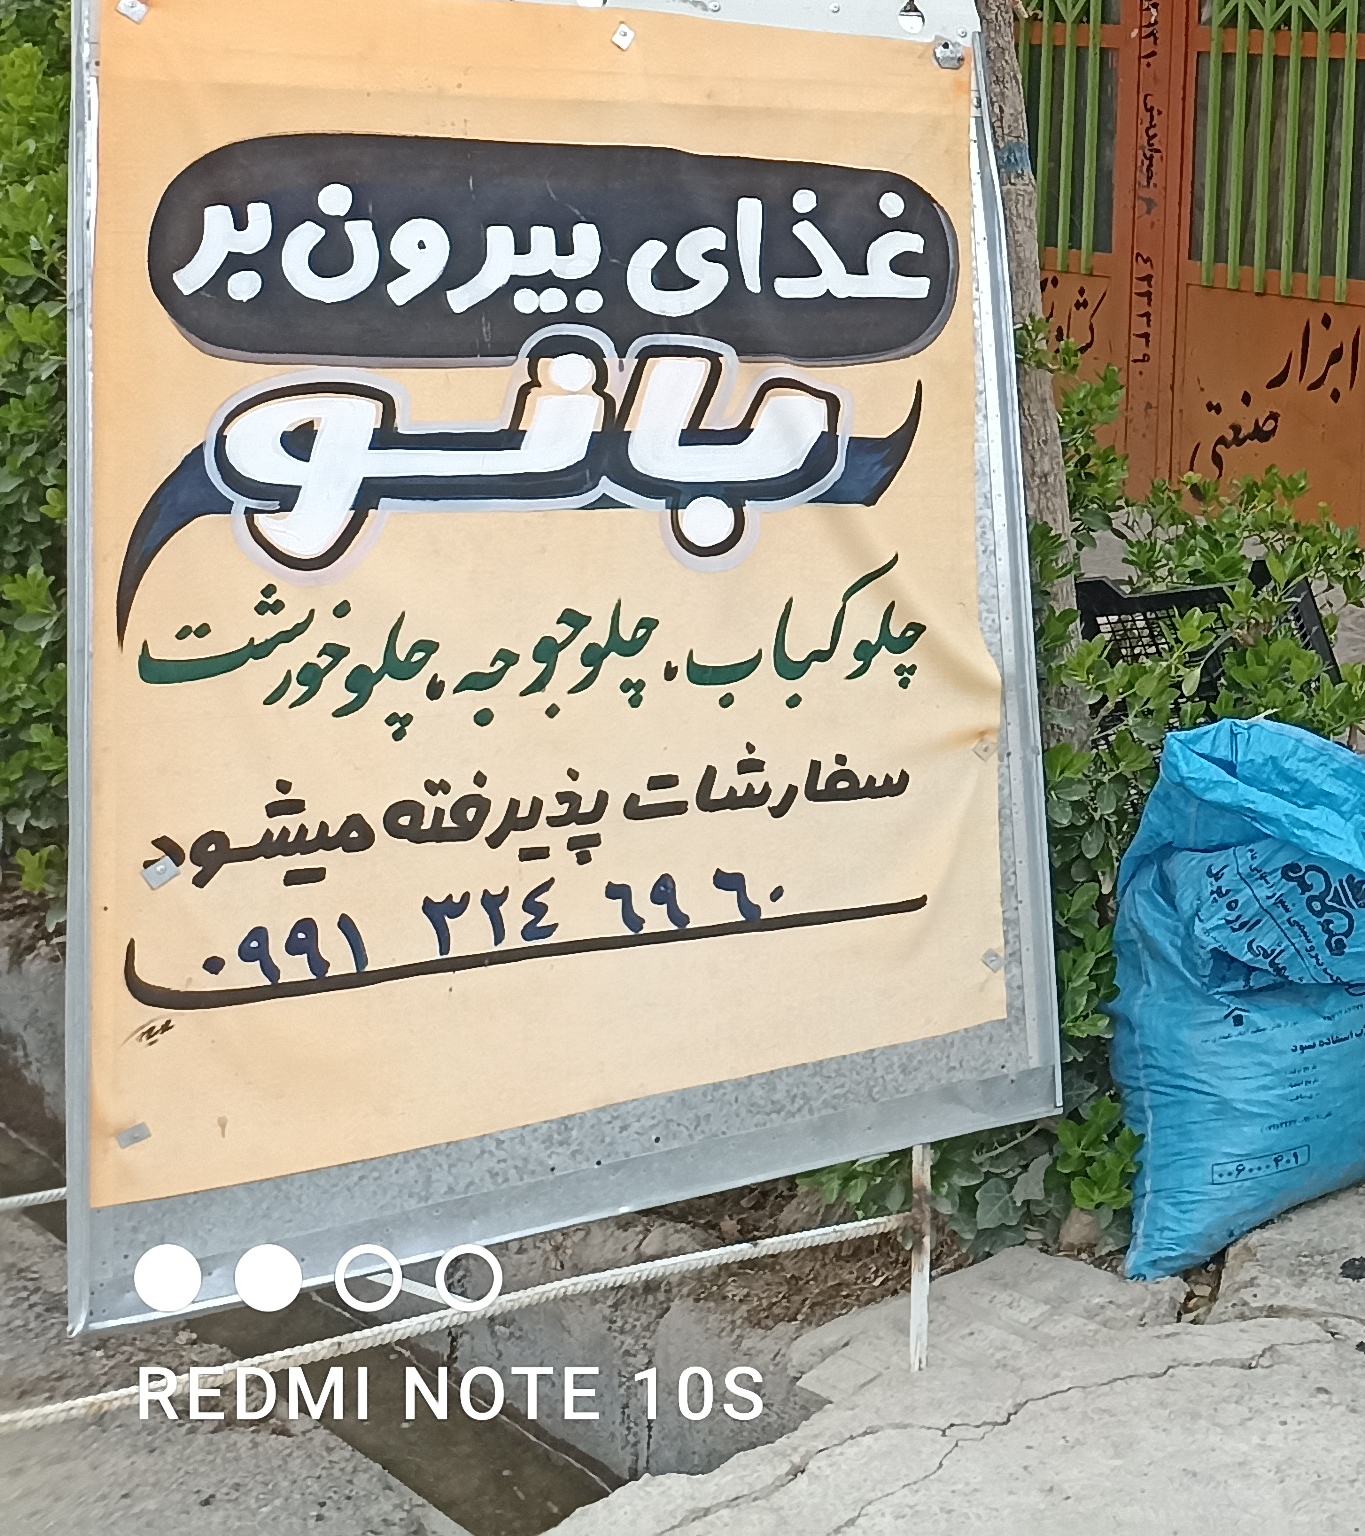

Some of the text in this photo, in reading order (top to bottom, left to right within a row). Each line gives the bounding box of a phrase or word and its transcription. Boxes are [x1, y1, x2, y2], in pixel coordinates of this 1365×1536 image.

[626, 187, 931, 316] غذای
[1265, 313, 1361, 403] ابزار
[216, 334, 842, 570] بانو
[141, 742, 911, 888] سفارشات پذیرفته میشود
[202, 911, 369, 985] ۰۹۹۱
